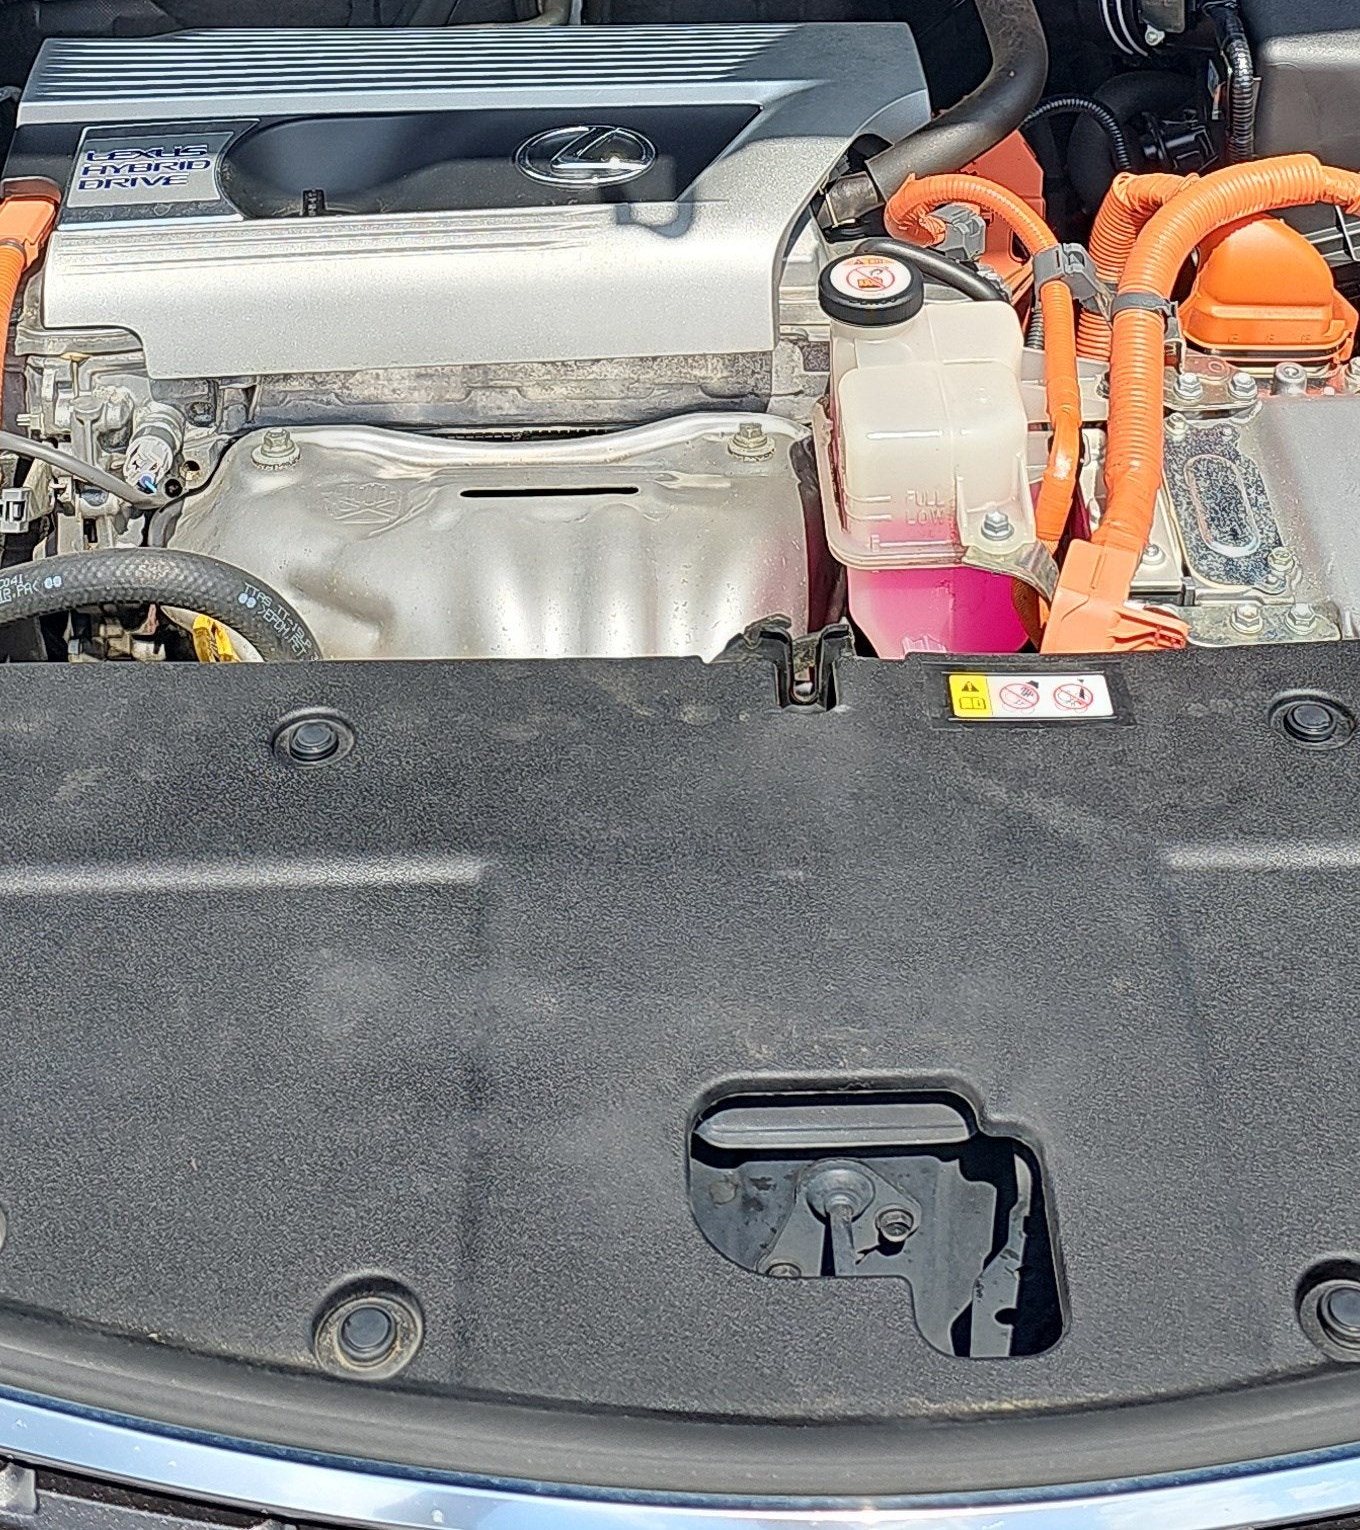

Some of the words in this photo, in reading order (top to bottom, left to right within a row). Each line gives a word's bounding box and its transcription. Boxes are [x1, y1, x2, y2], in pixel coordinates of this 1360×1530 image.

[86, 144, 208, 162] LEXUS
[82, 159, 211, 176] HYBRID
[77, 173, 190, 191] DRIVE
[905, 489, 945, 507] FULL
[905, 508, 945, 526] LOW
